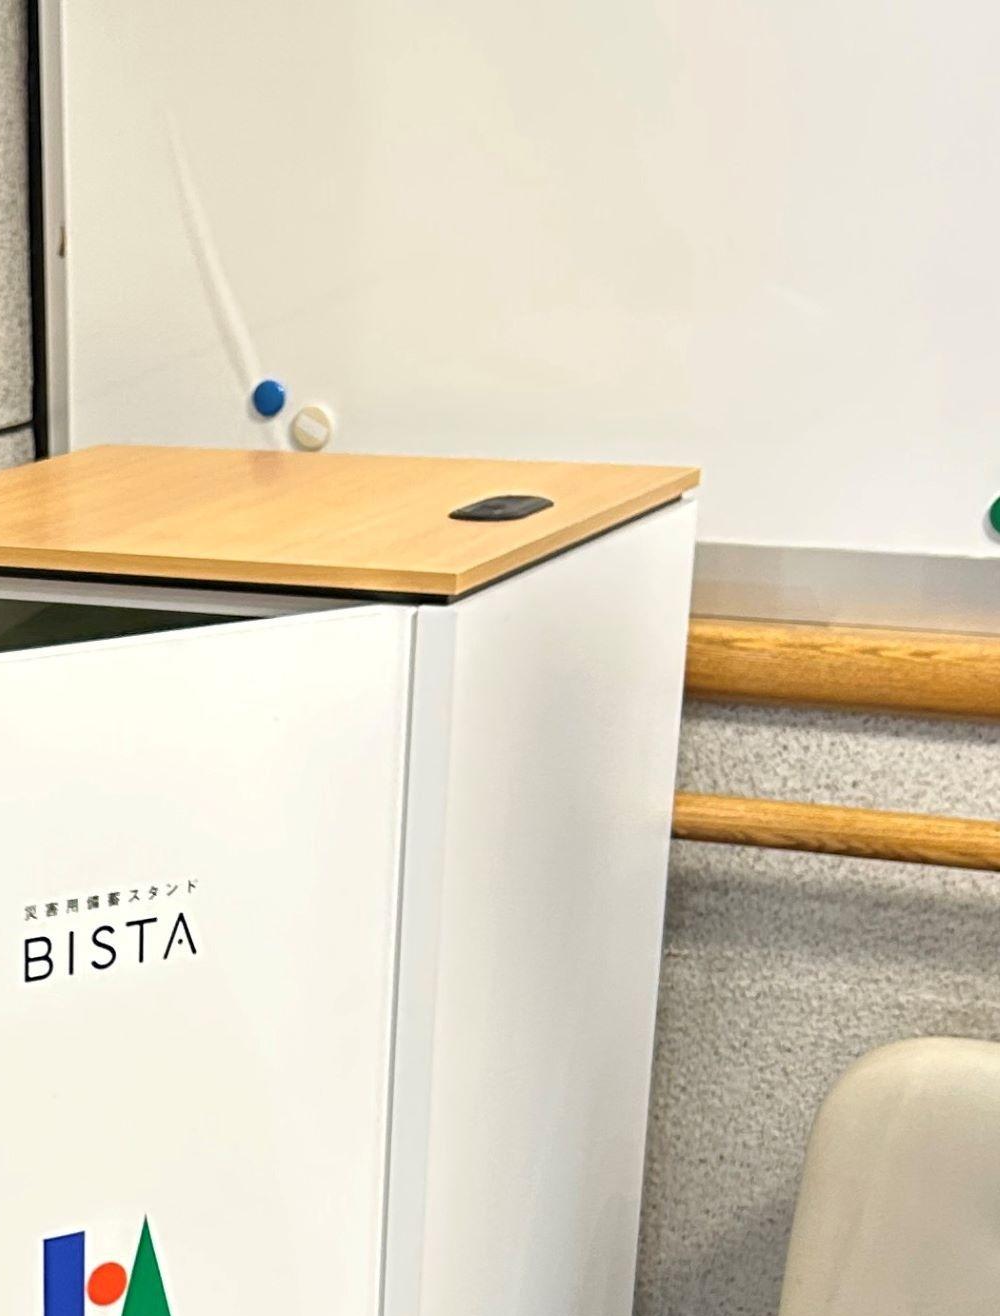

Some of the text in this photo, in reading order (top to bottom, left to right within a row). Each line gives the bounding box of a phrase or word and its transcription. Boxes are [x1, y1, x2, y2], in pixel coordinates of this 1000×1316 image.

[24, 879, 199, 921] 災害用備蓄スタンド
[24, 912, 198, 983] BISTA
